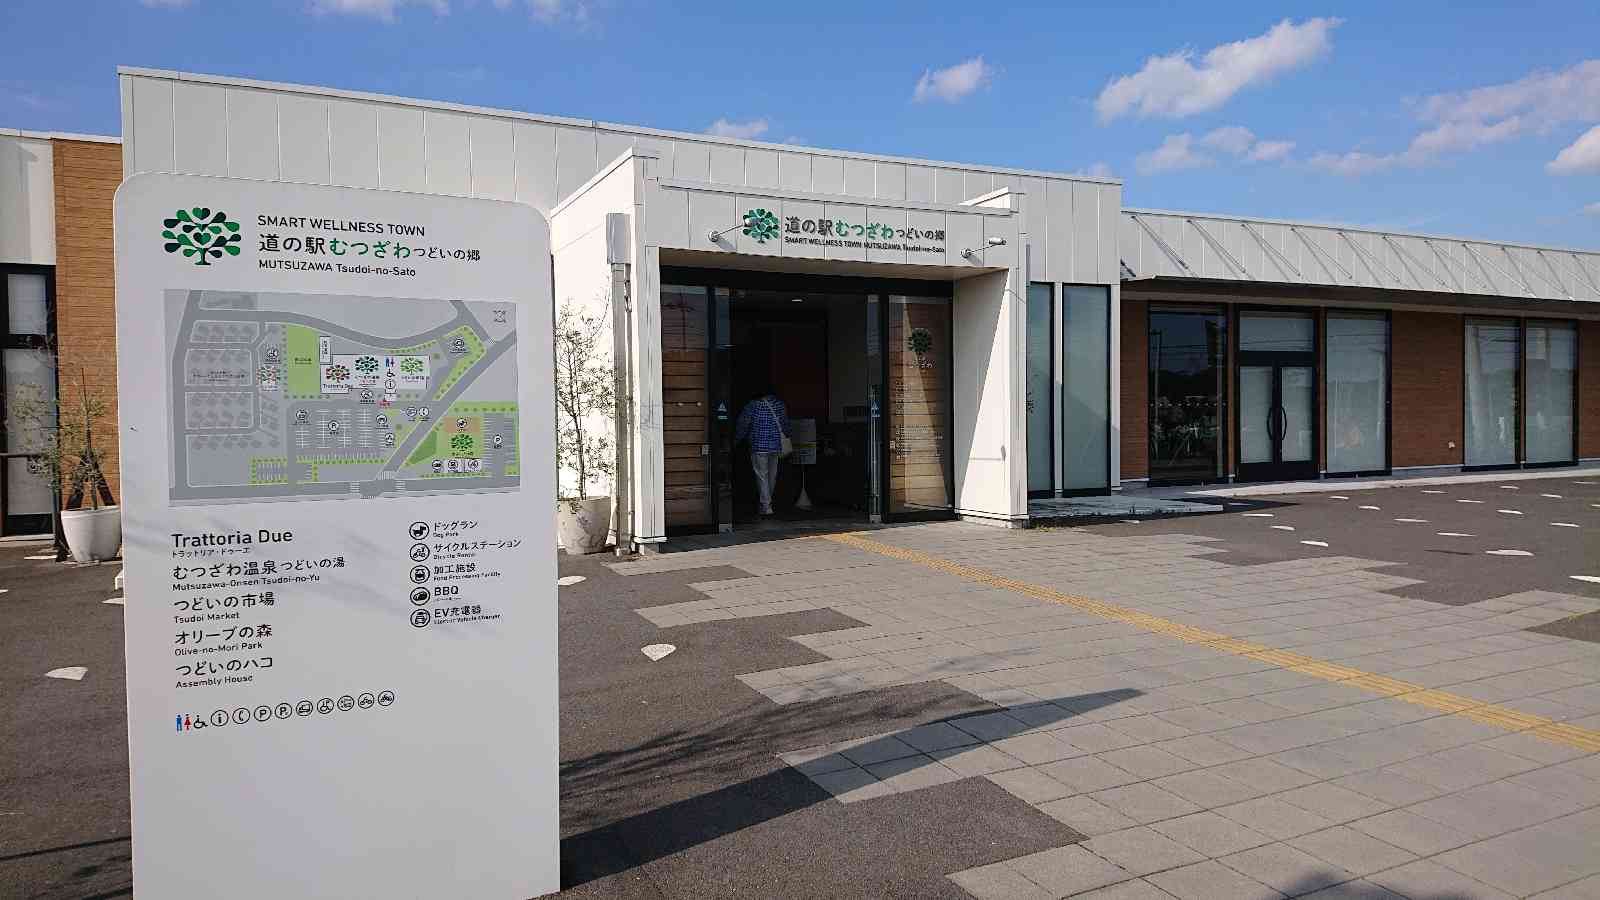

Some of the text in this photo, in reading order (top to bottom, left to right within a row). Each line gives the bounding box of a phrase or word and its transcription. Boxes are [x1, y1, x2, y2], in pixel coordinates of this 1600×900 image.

[258, 214, 425, 237] SMART WELLNESS TOWN
[785, 215, 946, 241] 道の駅むつざわつどいの郷
[258, 233, 481, 262] 道の駅むつざわつどいの郷
[785, 235, 808, 245] SMART
[809, 238, 843, 248] WELLNESS
[844, 240, 862, 249] TOWN
[864, 241, 902, 251] MUTSUZAWA
[258, 259, 417, 277] MUTSUZAWA Tsudoi-no-Sato
[433, 520, 478, 532] ドッグラン
[171, 530, 293, 548] Trattoria Due
[433, 539, 522, 553] サイクルステーション
[172, 556, 345, 581] むつざわ温泉つどいの湯
[433, 563, 476, 575] 加工施設
[172, 574, 320, 592] Mutsuzawa-Onsen Tsudoi-no-Yu
[434, 585, 459, 597] BBQ
[174, 591, 275, 611] つどいの市場
[174, 612, 240, 624] Tsudoi Market
[434, 604, 481, 618] EV充電器
[175, 623, 273, 645] オリーブの森
[174, 641, 263, 656] Olive-no-Mori Park
[175, 657, 274, 677] つどいのハコ
[175, 674, 253, 688] Assembly House
